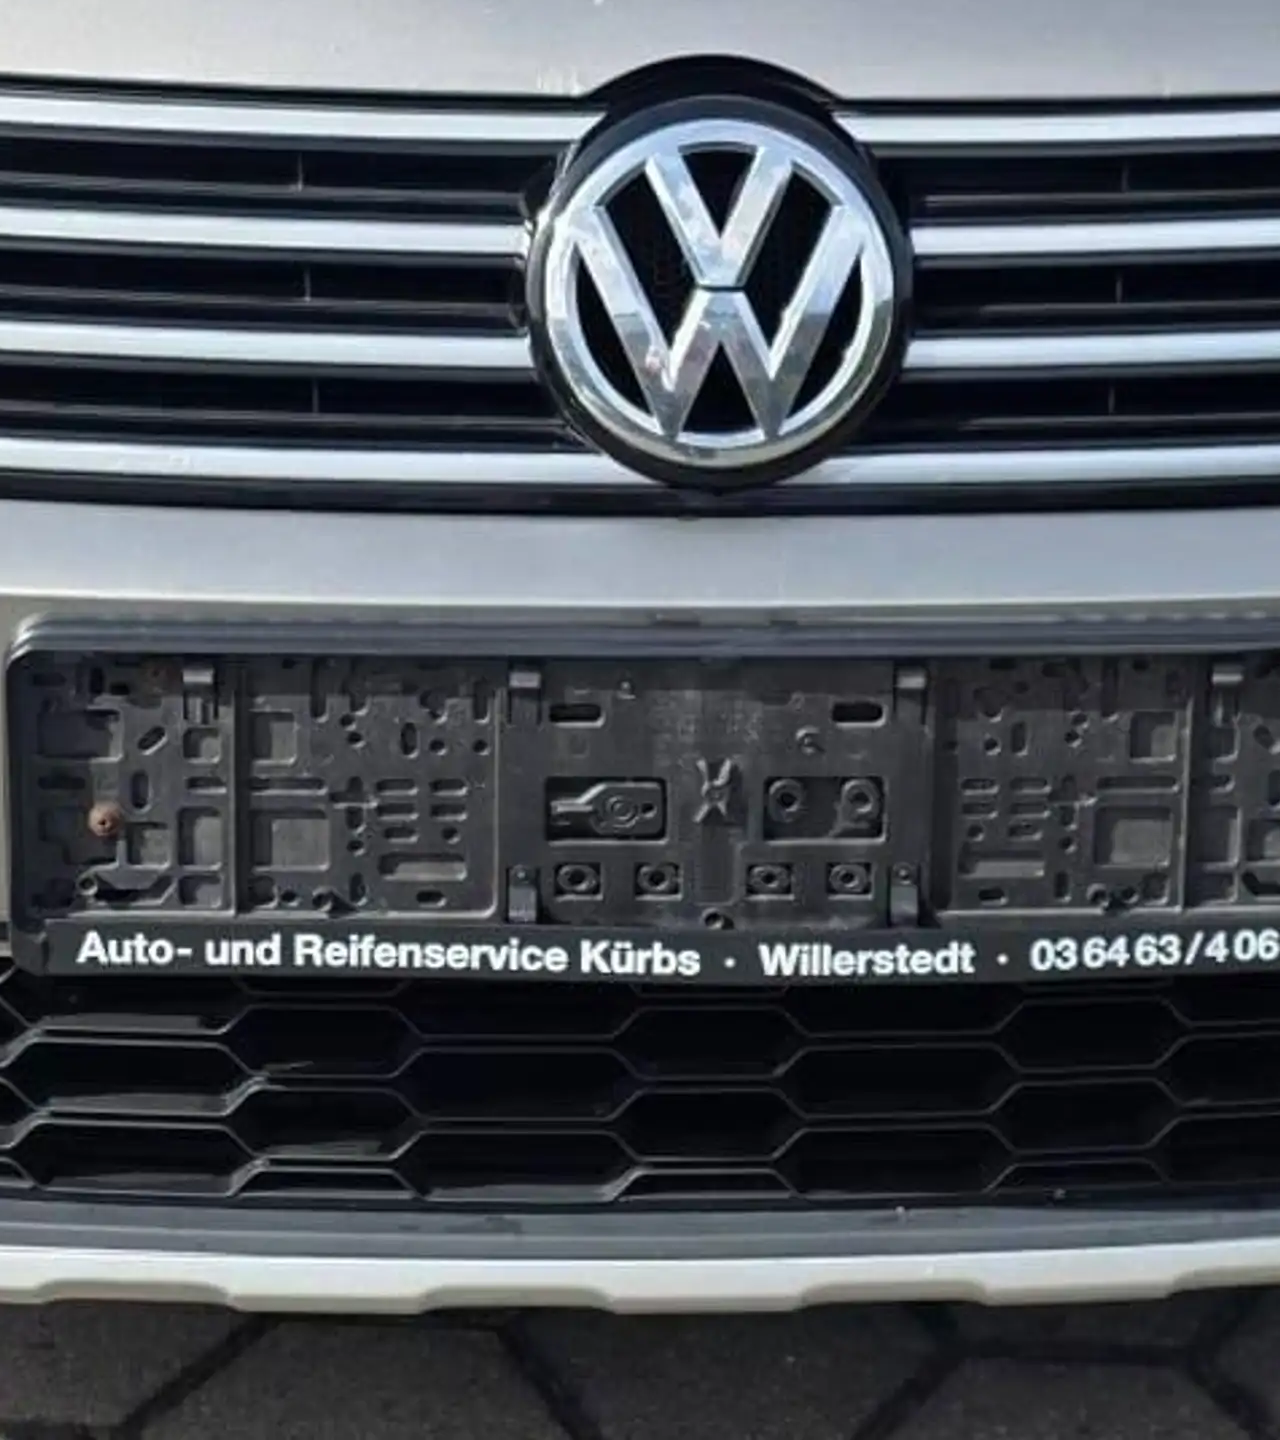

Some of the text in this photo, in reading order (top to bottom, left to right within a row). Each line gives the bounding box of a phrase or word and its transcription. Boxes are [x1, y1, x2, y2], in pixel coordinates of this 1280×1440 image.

[570, 138, 868, 446] VW
[75, 930, 193, 965] Auto-
[204, 933, 282, 966] und
[293, 933, 569, 973] Reifenservice
[579, 938, 701, 976] Kürbs
[757, 940, 976, 976] Willerstedt
